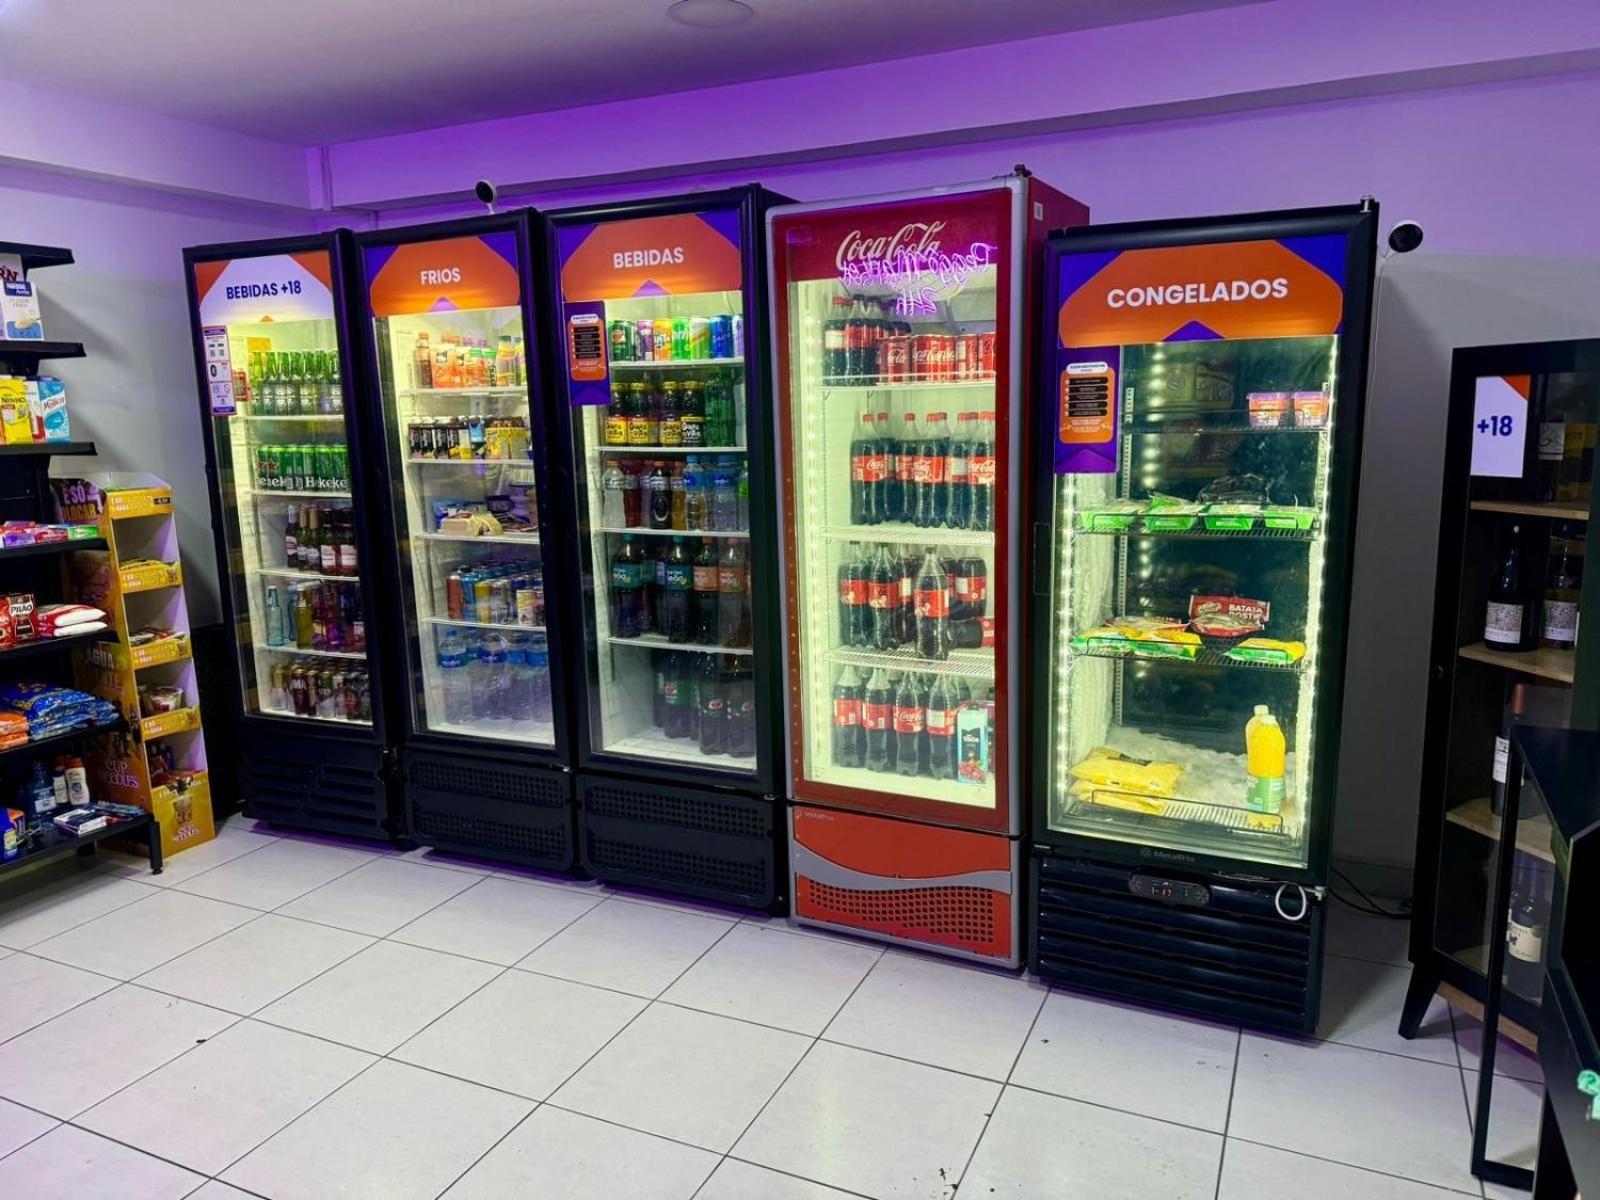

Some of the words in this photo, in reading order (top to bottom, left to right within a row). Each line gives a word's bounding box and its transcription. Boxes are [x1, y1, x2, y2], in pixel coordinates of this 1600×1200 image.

[835, 221, 947, 270] Coca-Cola
[613, 247, 684, 269] BEBIDAS
[420, 267, 461, 285] FRIOS
[226, 284, 278, 300] BEBIDAS
[281, 280, 302, 296] +18
[1107, 278, 1288, 308] CONGELADOS
[1477, 415, 1513, 437] +18
[1229, 604, 1263, 613] BATATA
